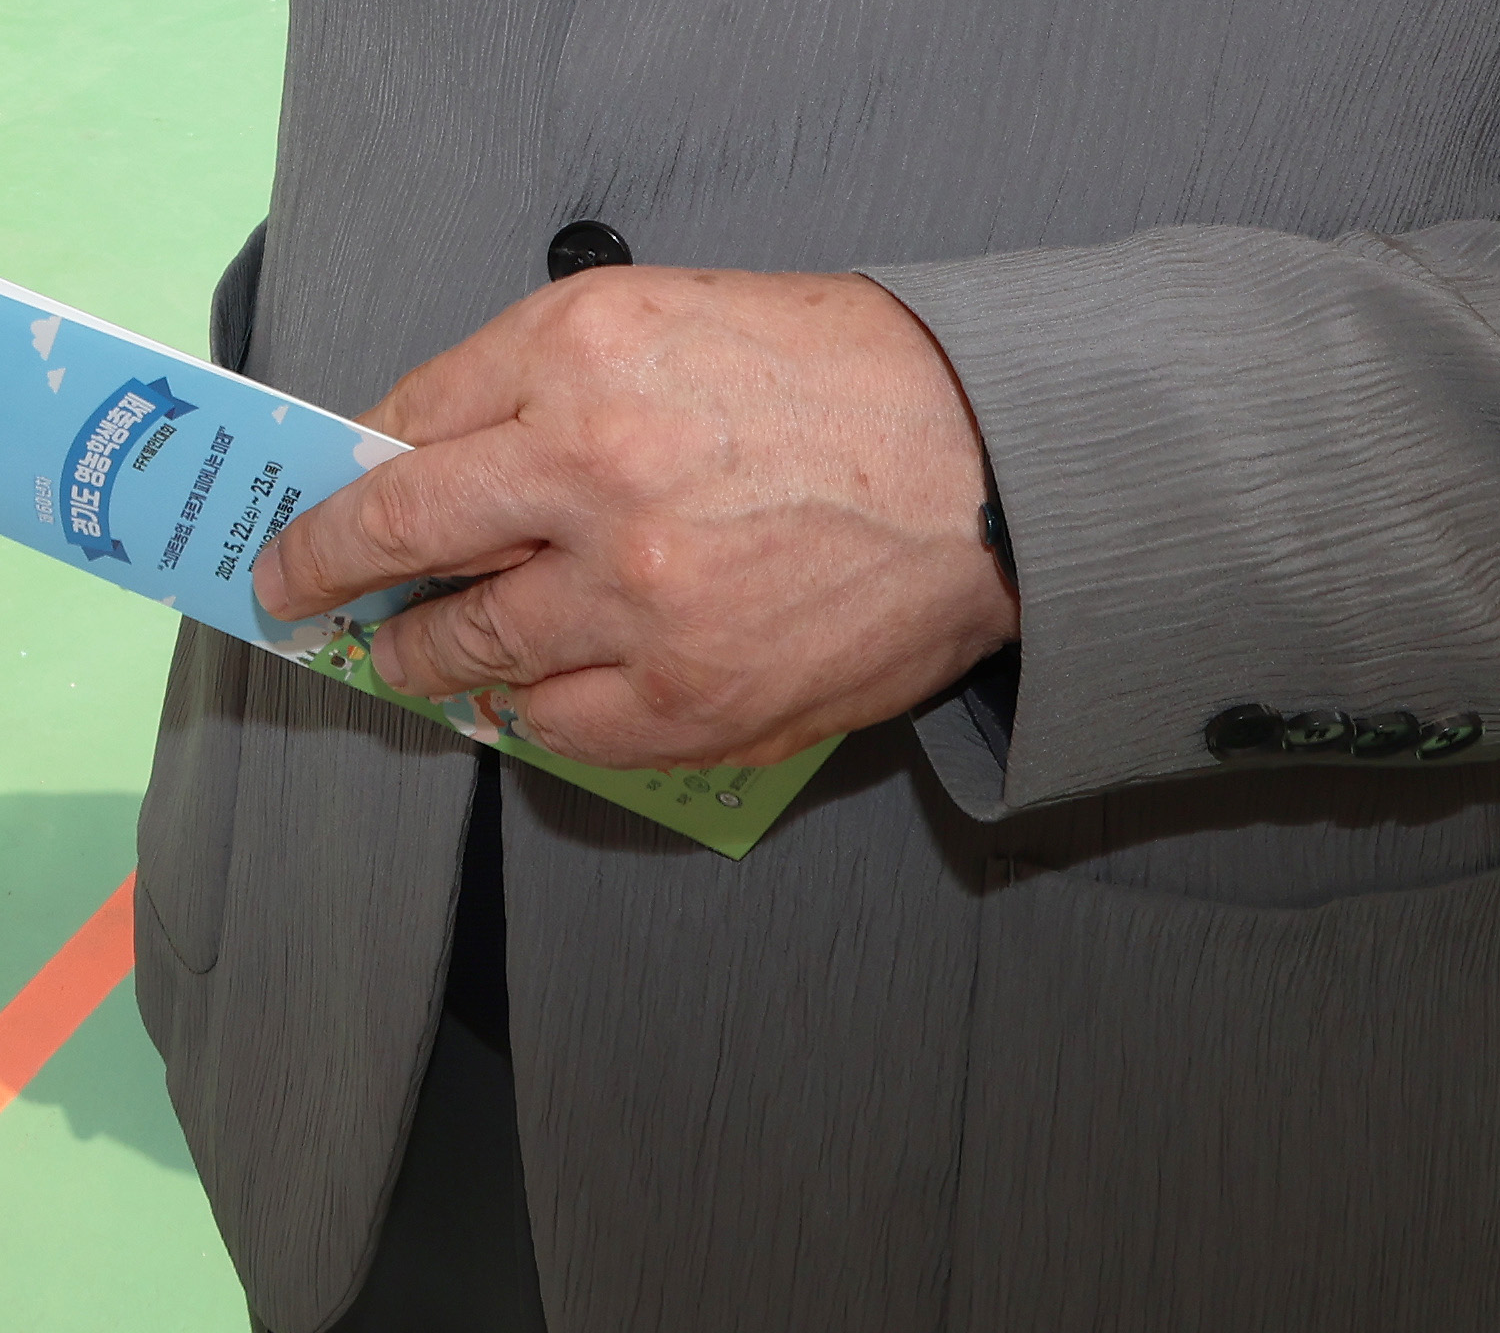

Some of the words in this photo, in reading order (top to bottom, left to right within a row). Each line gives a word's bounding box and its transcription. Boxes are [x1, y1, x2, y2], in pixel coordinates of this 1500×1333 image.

[74, 391, 157, 487] 영농학생축제
[195, 455, 224, 494] 피어나는
[70, 484, 101, 537] 경기도
[215, 552, 241, 582] 2024.
